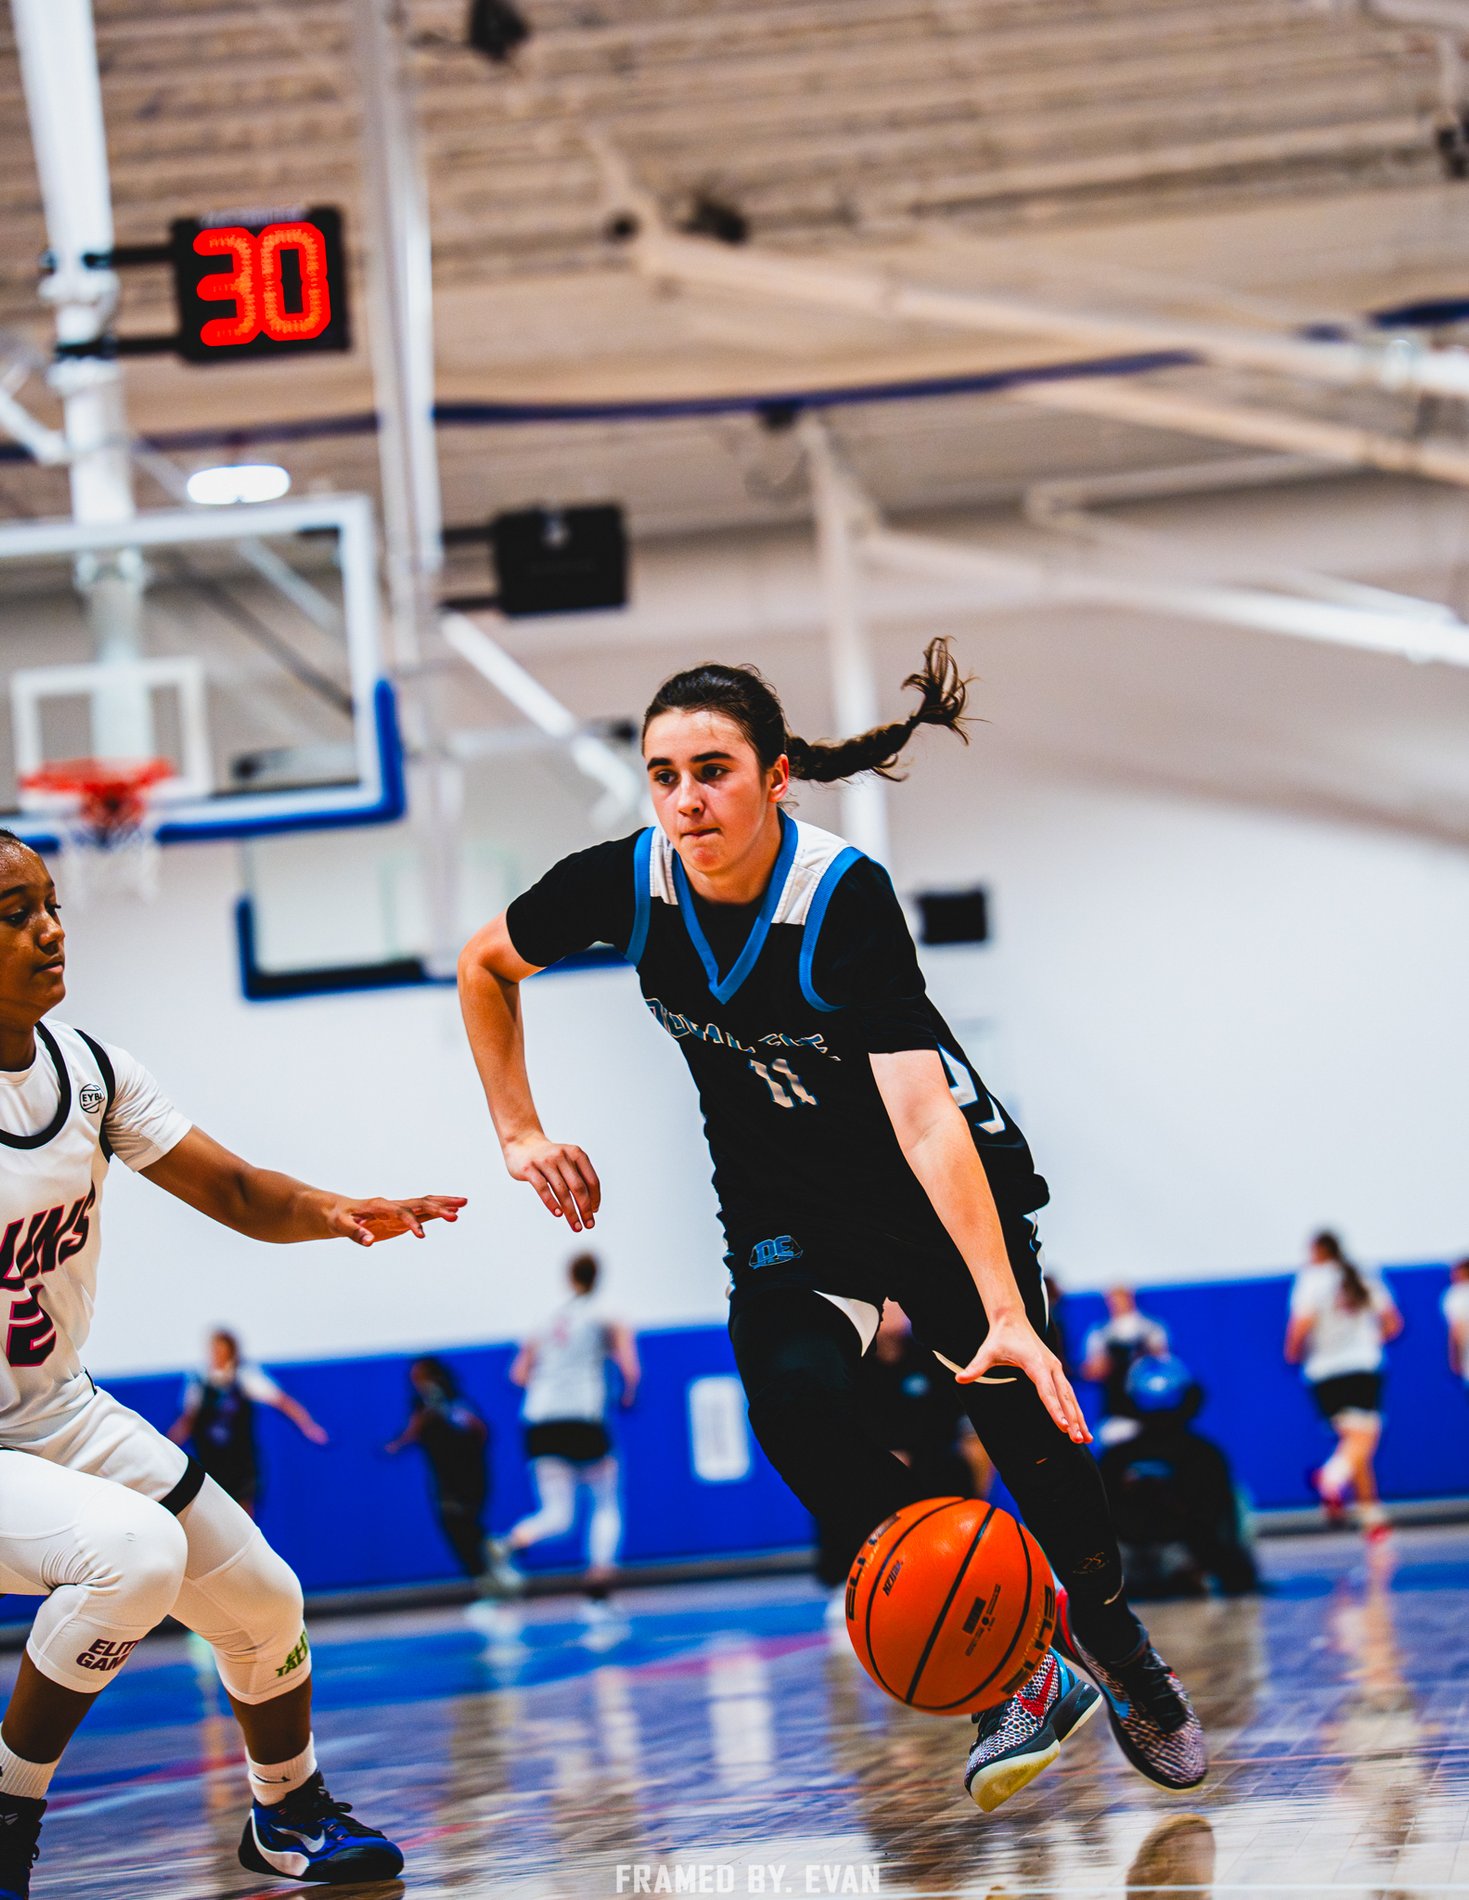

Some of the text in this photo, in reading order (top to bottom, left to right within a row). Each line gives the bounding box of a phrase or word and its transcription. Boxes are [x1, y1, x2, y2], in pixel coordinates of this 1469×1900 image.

[193, 222, 332, 347] 30
[750, 1062, 818, 1108] 11
[76, 1651, 129, 1671] GAM
